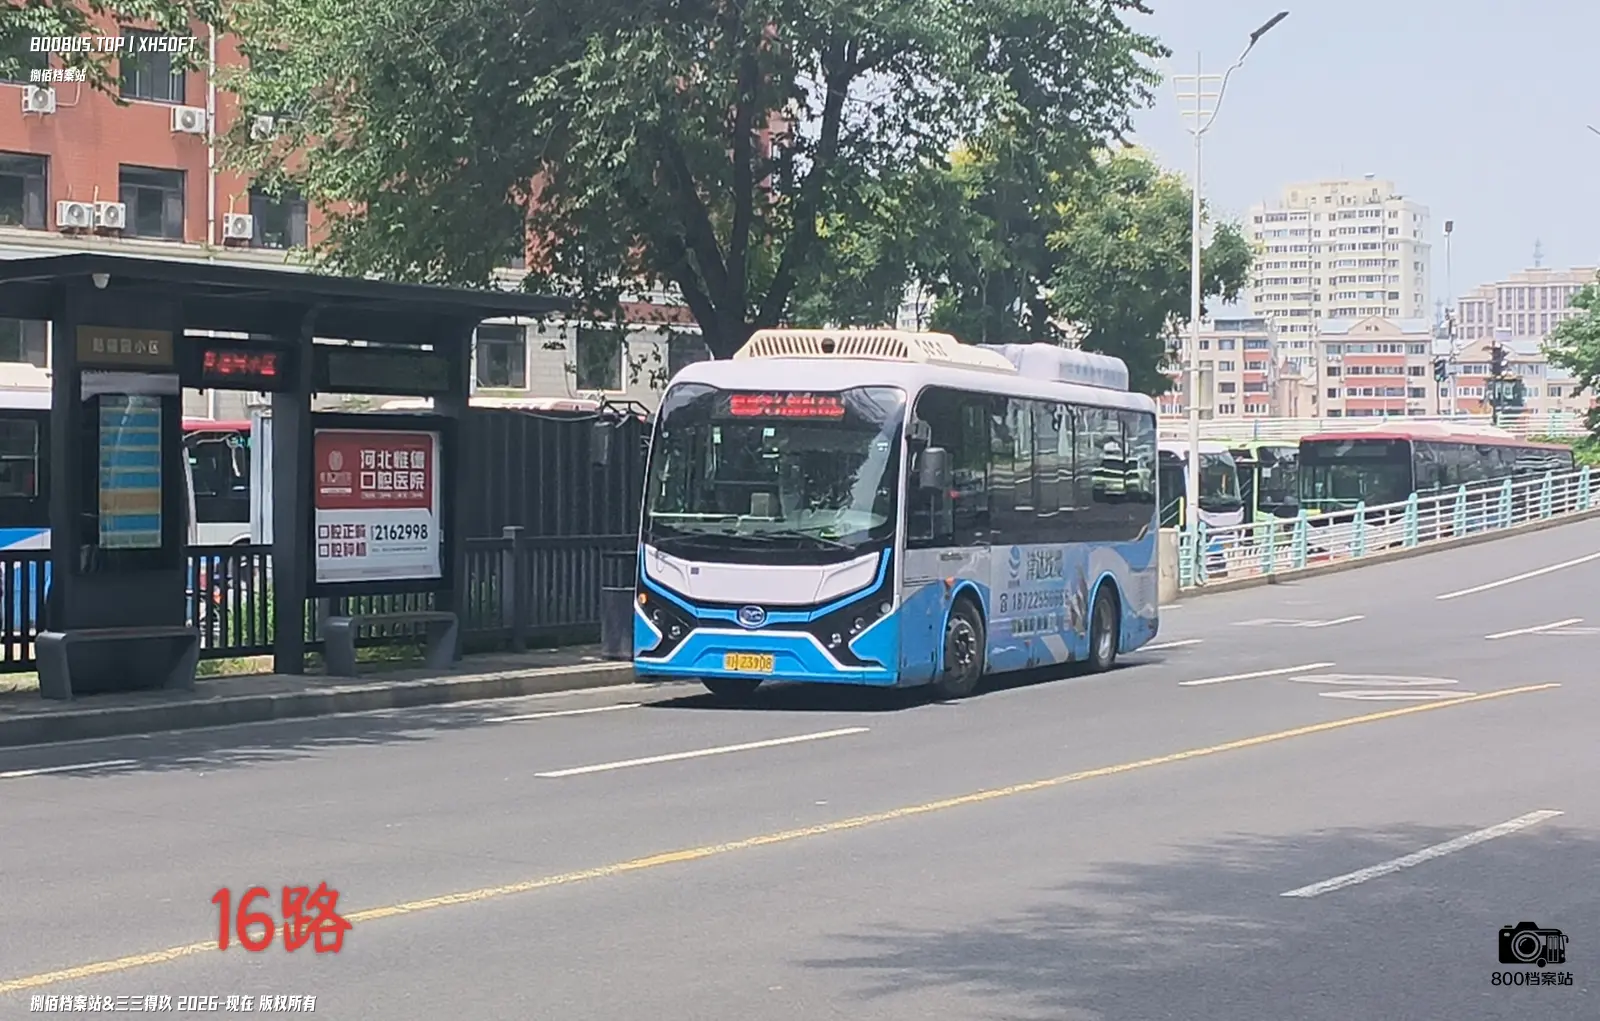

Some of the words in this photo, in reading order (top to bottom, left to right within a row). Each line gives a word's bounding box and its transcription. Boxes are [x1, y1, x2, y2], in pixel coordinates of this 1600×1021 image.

[361, 471, 425, 490] 口腔医院
[375, 523, 429, 541] 2162998
